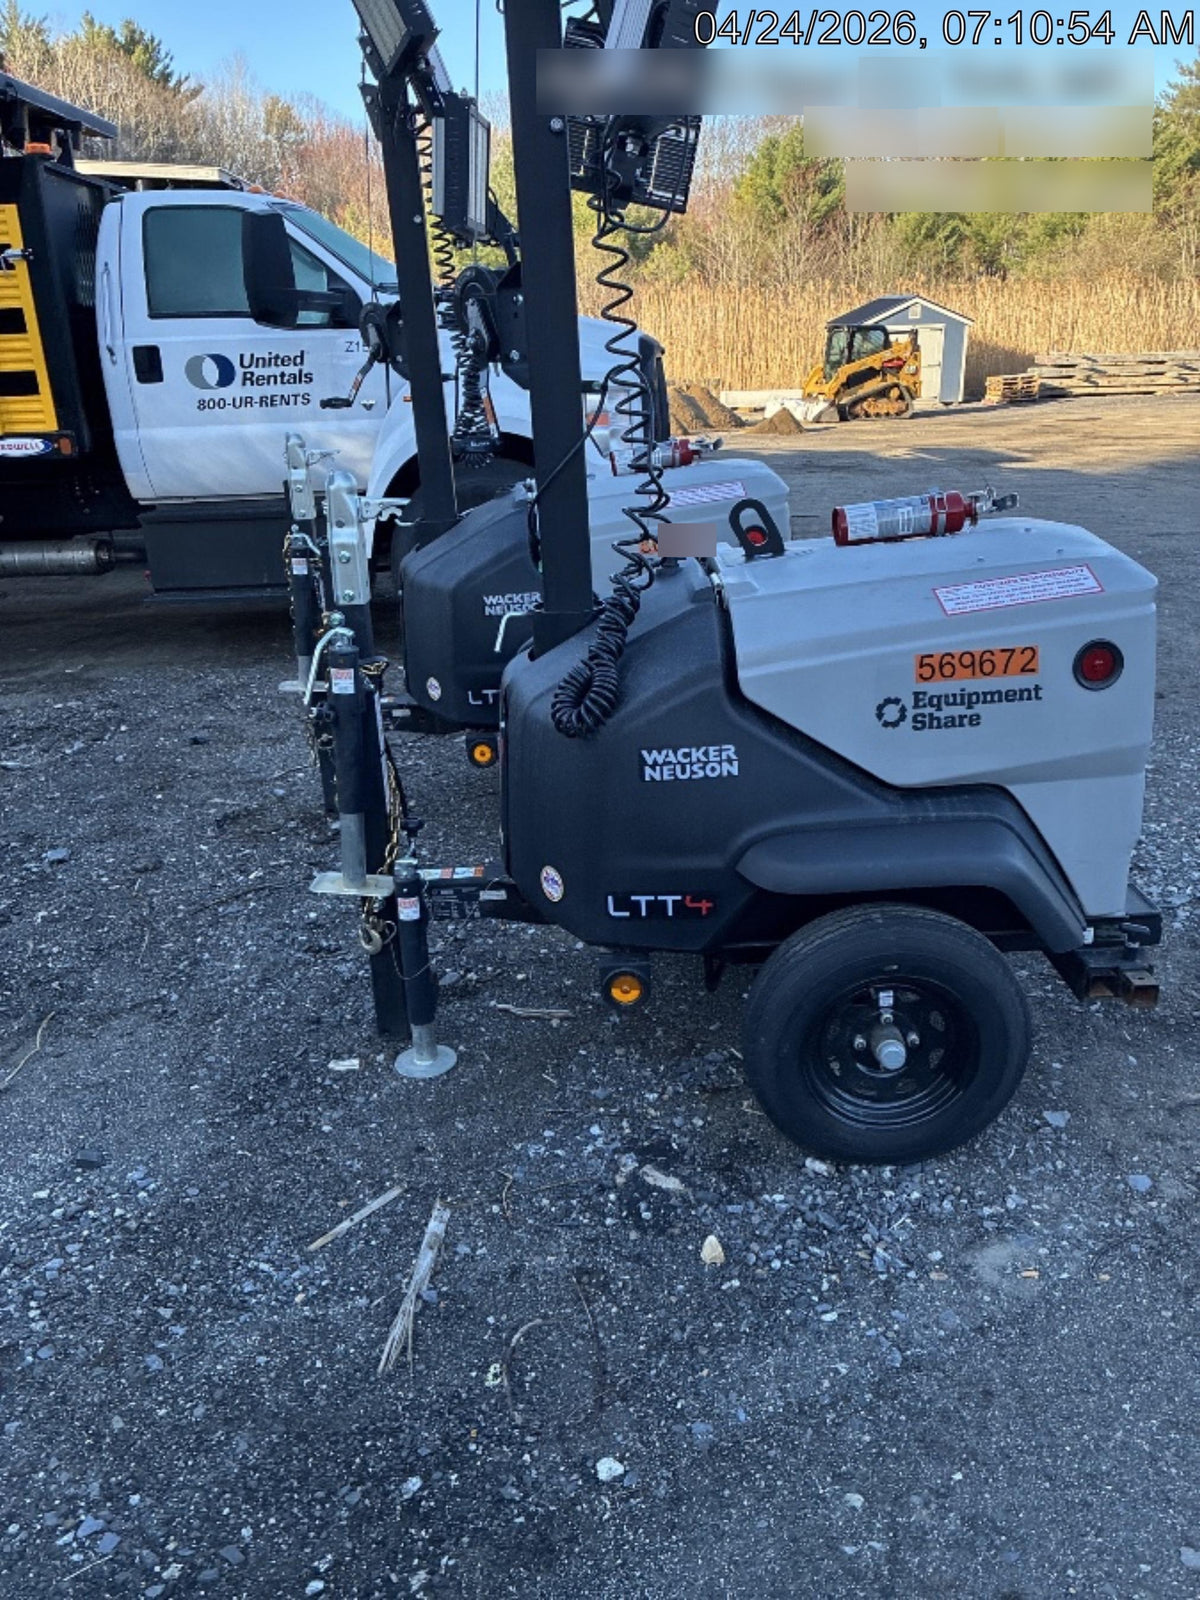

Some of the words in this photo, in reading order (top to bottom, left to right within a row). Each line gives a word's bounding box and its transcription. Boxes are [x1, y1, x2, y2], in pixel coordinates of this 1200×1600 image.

[239, 350, 305, 368] United
[241, 369, 314, 387] Rentals
[197, 393, 311, 411] 800-UR-RENTS
[483, 592, 542, 604] WACKER
[918, 646, 1037, 682] 569672
[467, 689, 501, 705] LT
[912, 684, 1043, 711] Equipment
[912, 712, 982, 731] Share
[641, 744, 738, 765] WACKER
[644, 760, 739, 781] NEUSON
[607, 895, 713, 917] LTT4
